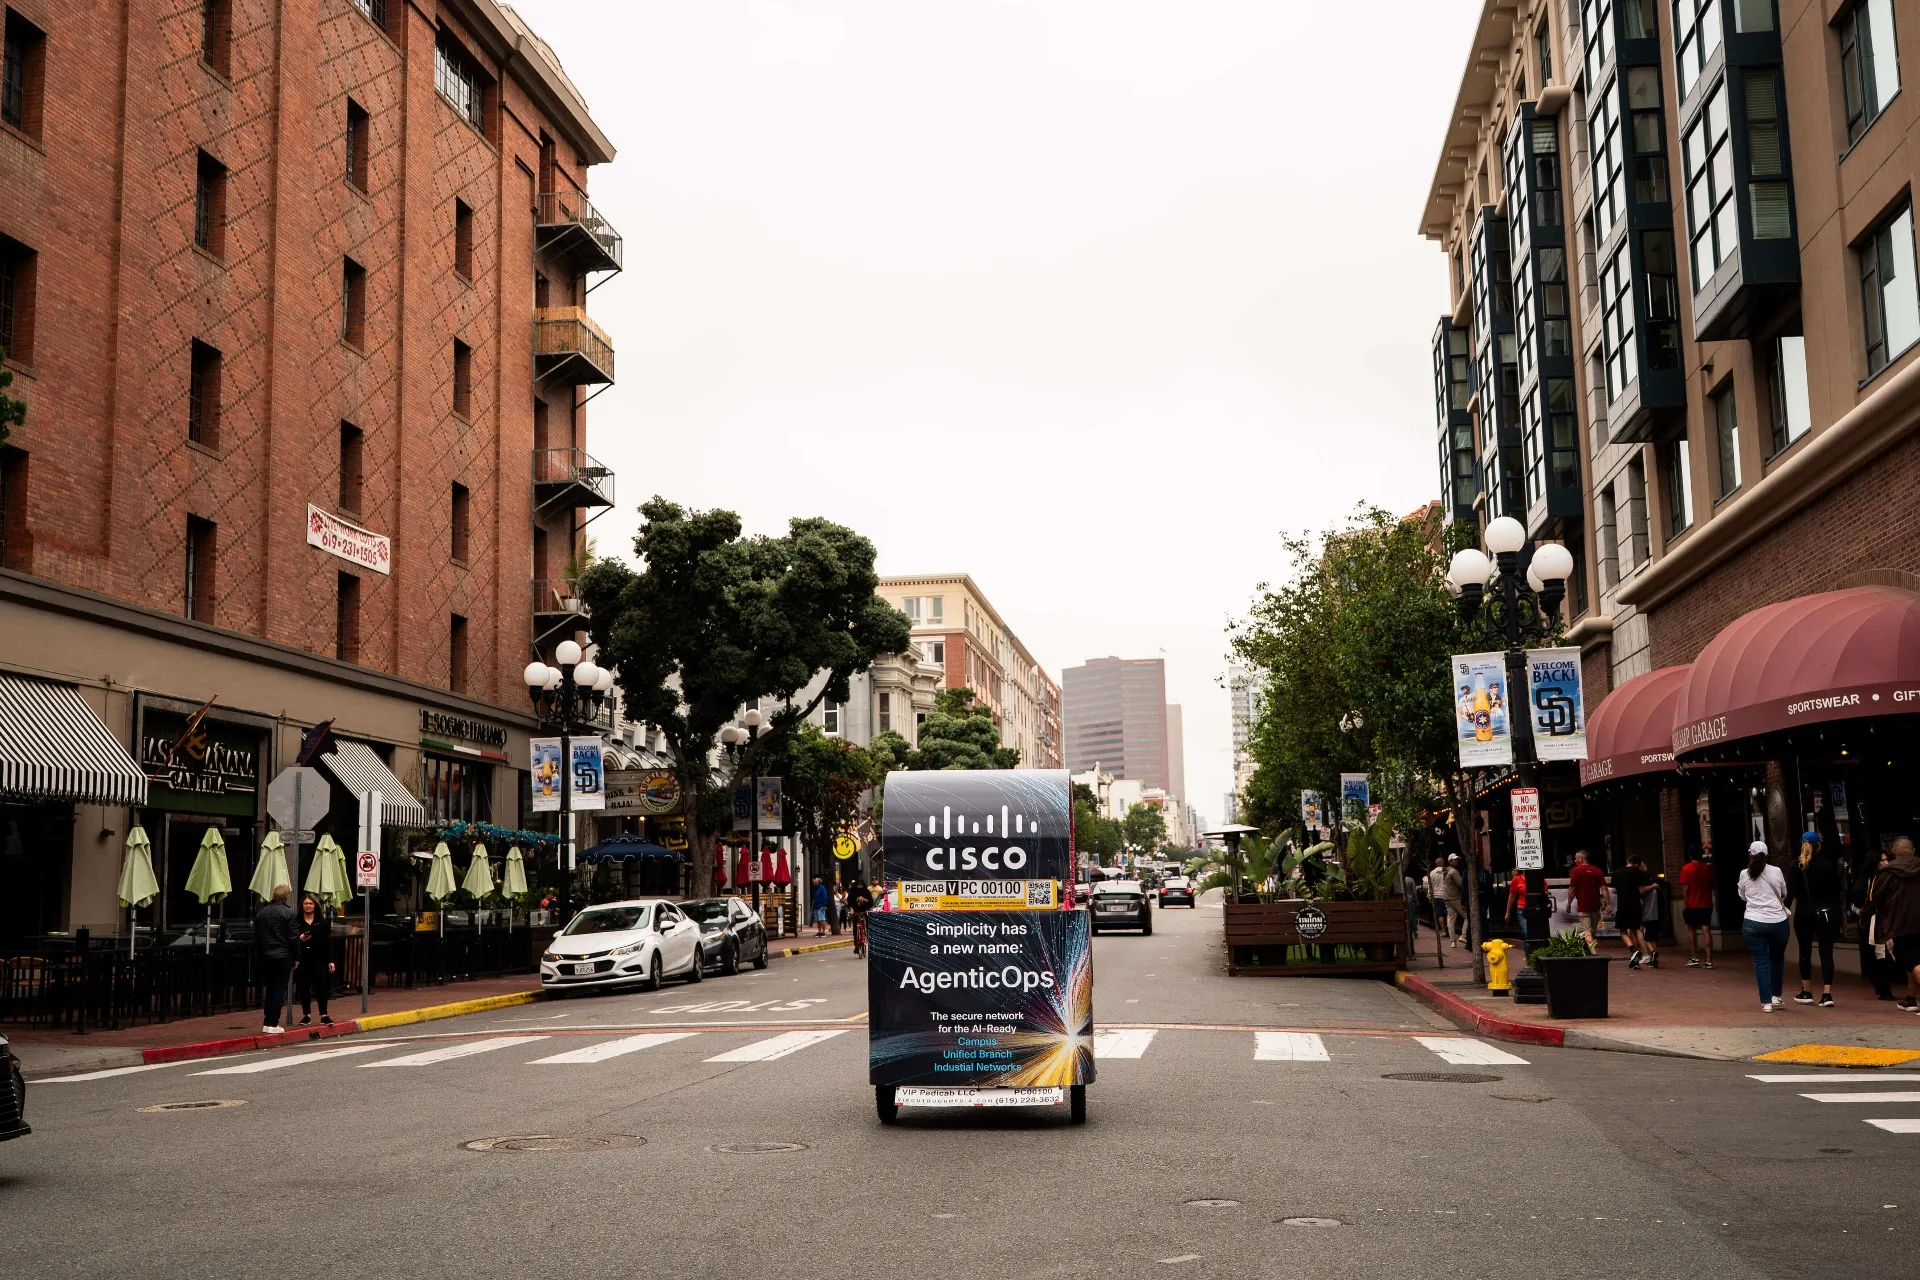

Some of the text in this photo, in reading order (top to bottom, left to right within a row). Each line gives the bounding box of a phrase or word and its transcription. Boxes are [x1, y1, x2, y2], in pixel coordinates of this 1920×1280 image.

[1532, 660, 1575, 671] WELCOME
[1532, 669, 1576, 684] BACK!
[1787, 693, 1861, 716] SPORTSWEAR
[1692, 716, 1728, 745] GARAGE
[573, 750, 599, 759] BACK!
[1640, 752, 1676, 764] SPORTSW
[1587, 758, 1614, 782] GARAGE
[604, 788, 625, 800] RINK
[1344, 784, 1366, 792] BACK!
[611, 800, 633, 810] BAJA!
[1514, 804, 1536, 813] PARKING
[925, 847, 1027, 870] CISCO
[905, 881, 1021, 895] PEDICAB V PC 00100
[1298, 917, 1323, 928] UNION
[925, 922, 1028, 939] Simplicity has
[930, 943, 1023, 954] a new name:
[899, 965, 1055, 994] AgenticOps
[648, 998, 828, 1014] STOP
[930, 1012, 1024, 1021] The secure network
[938, 1024, 1017, 1036] for the AI-Ready
[957, 1037, 997, 1048] Campus
[943, 1049, 1012, 1059] Unified Branch
[976, 1062, 1022, 1072] Networks
